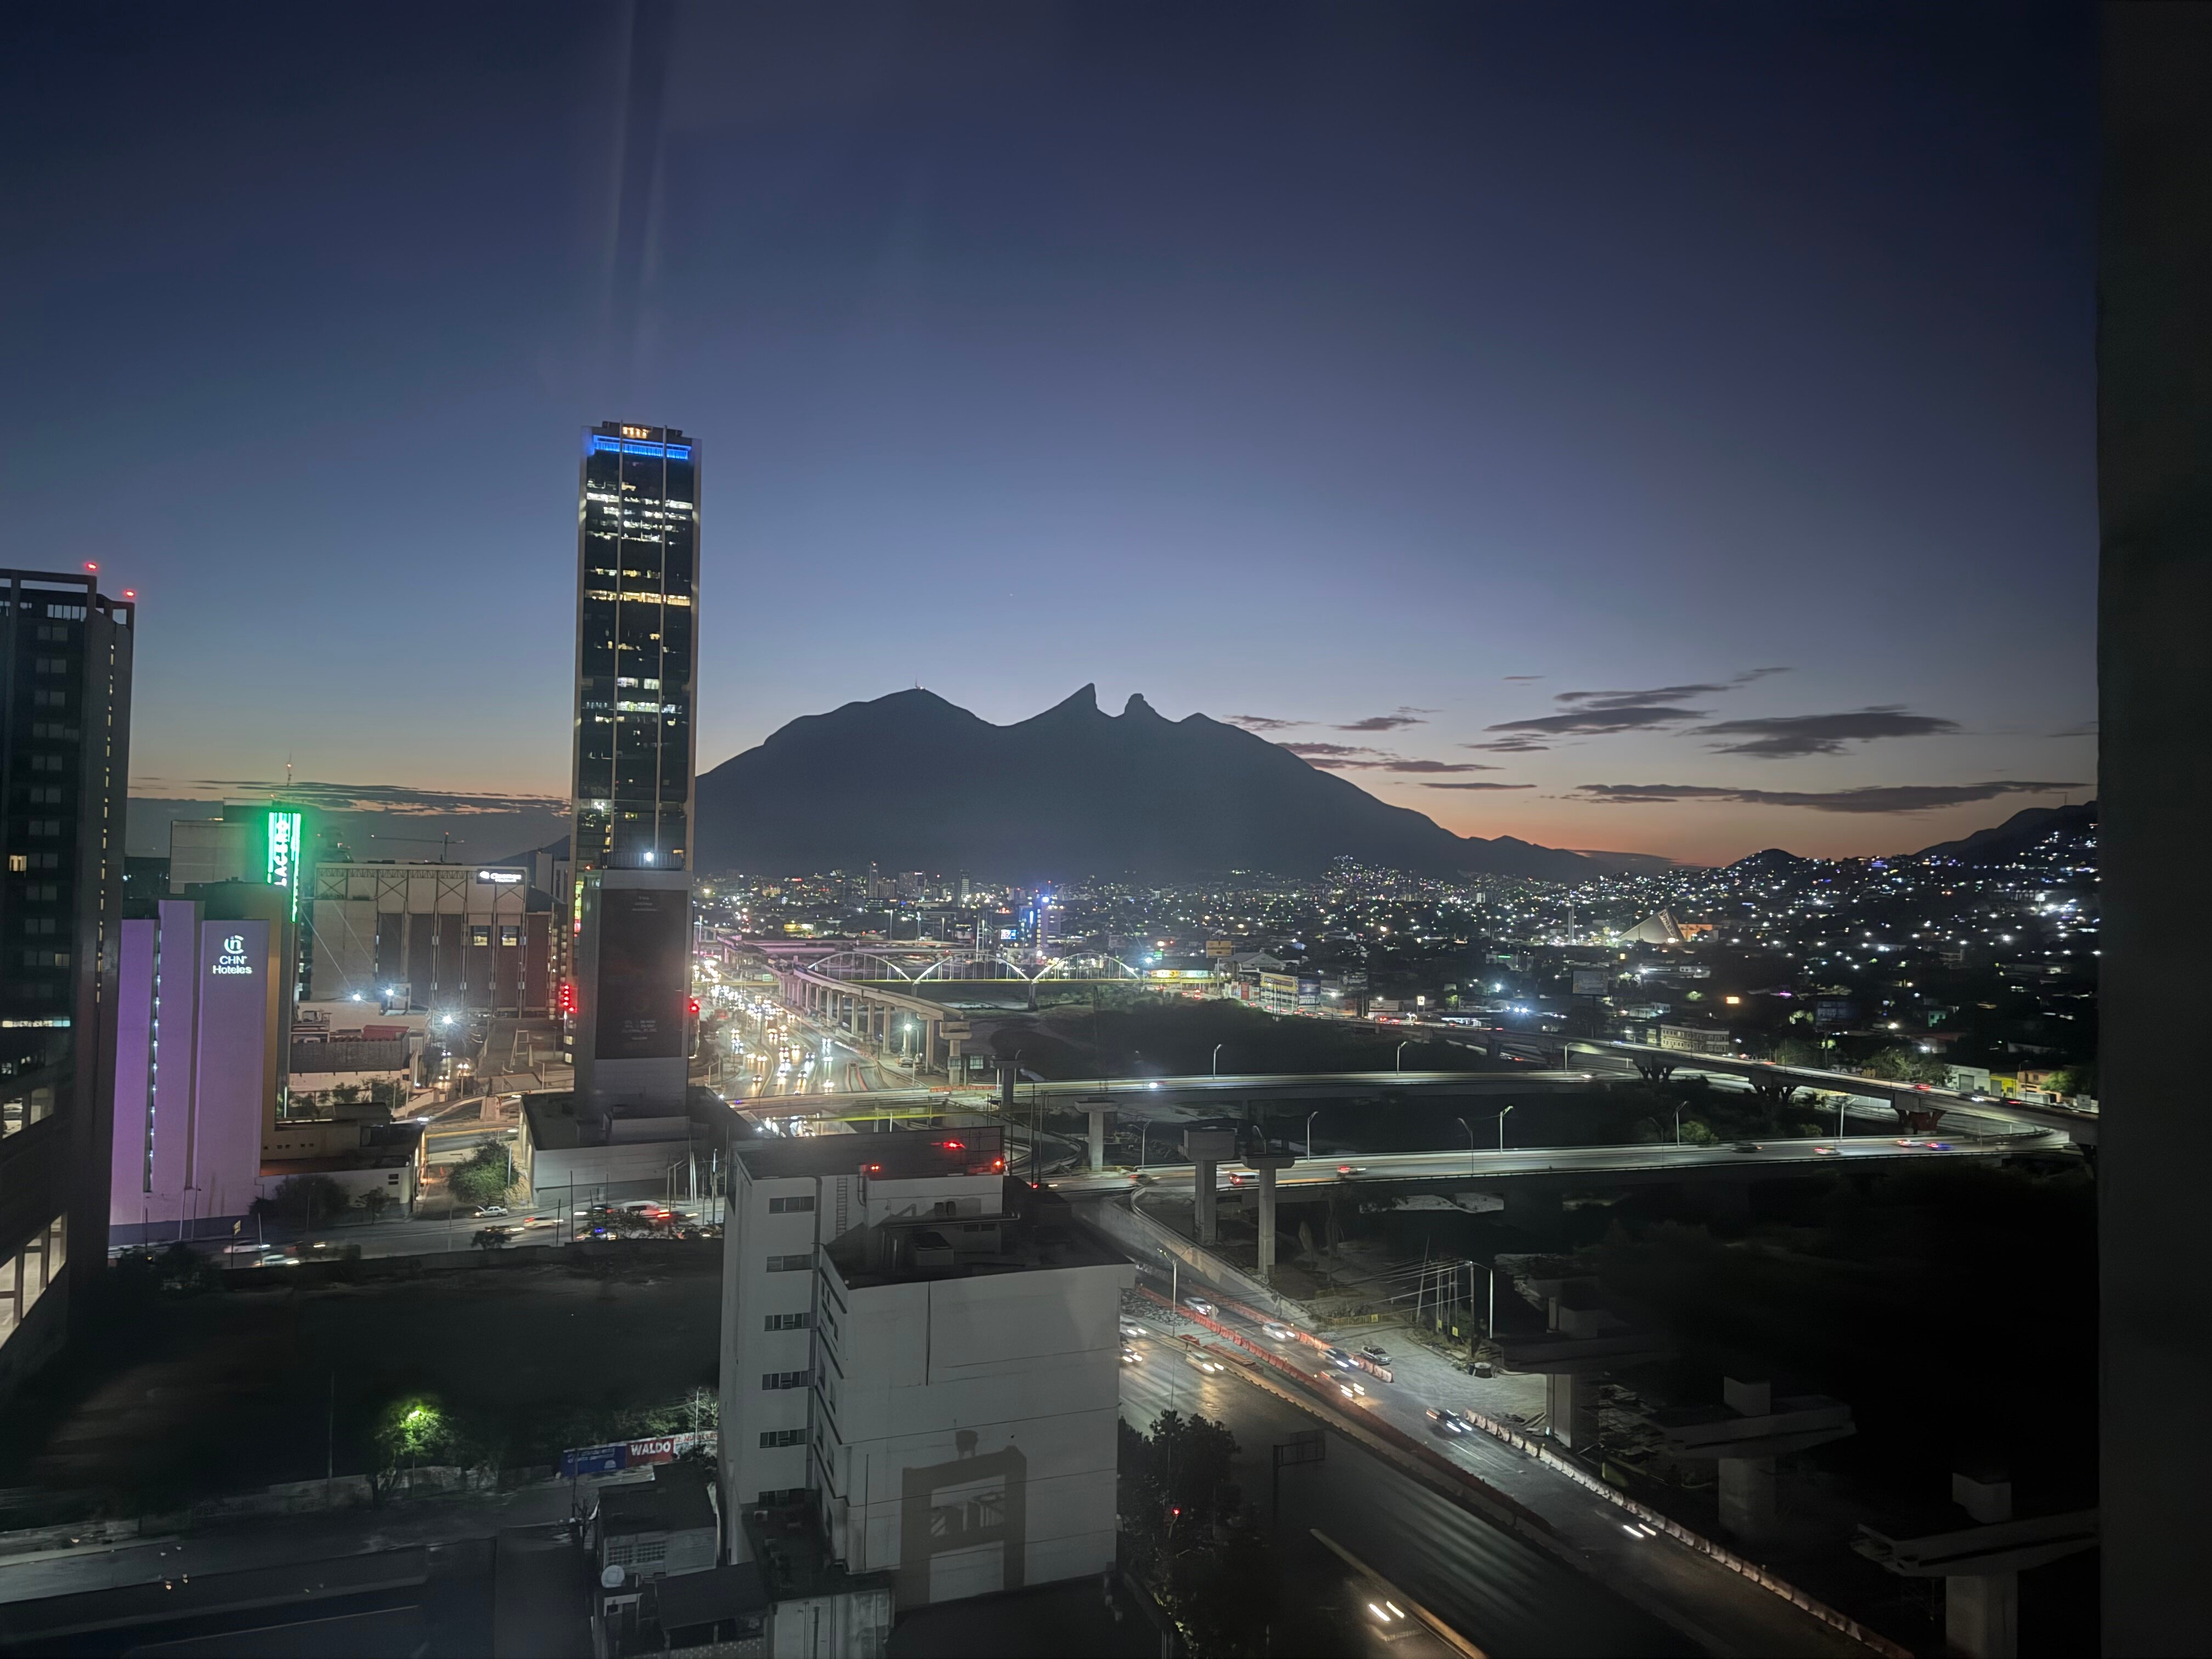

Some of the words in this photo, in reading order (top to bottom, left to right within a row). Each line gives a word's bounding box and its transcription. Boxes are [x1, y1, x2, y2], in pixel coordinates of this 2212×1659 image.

[219, 956, 245, 964] CHN
[213, 965, 252, 974] Hoteles
[631, 1441, 671, 1456] WALDO
